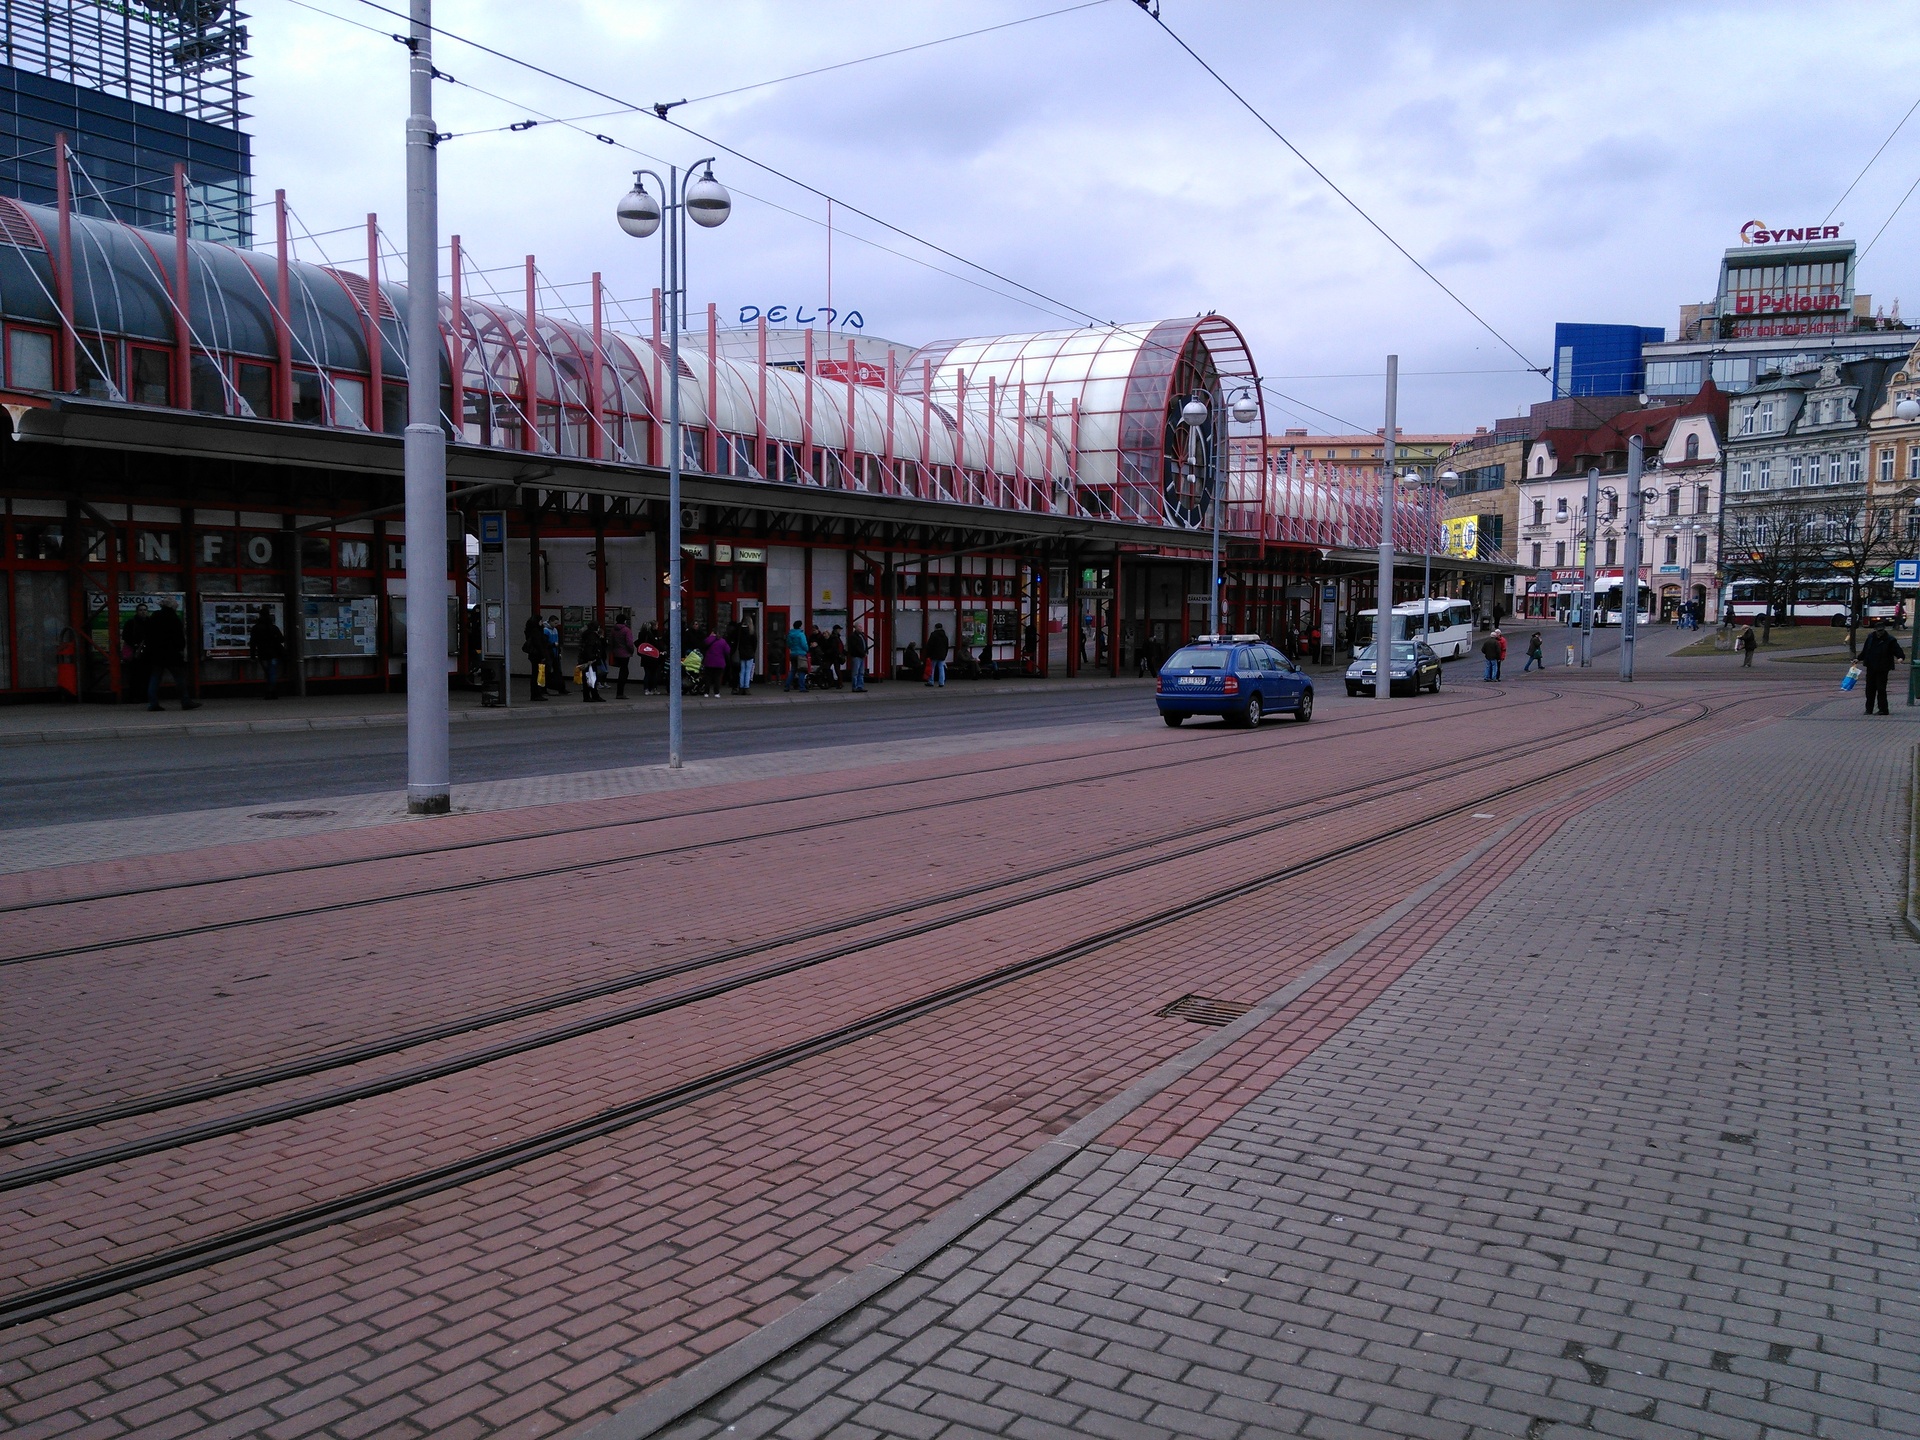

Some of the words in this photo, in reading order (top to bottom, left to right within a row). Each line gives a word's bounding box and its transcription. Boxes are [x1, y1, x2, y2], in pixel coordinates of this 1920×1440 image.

[1754, 226, 1840, 243] SYNER
[1759, 293, 1839, 312] Pytloun
[740, 305, 863, 328] DELTA
[1732, 327, 1754, 338] CITY
[1757, 324, 1807, 337] BOUTIQUE
[97, 530, 272, 564] INFO
[739, 550, 762, 560] NOVINY
